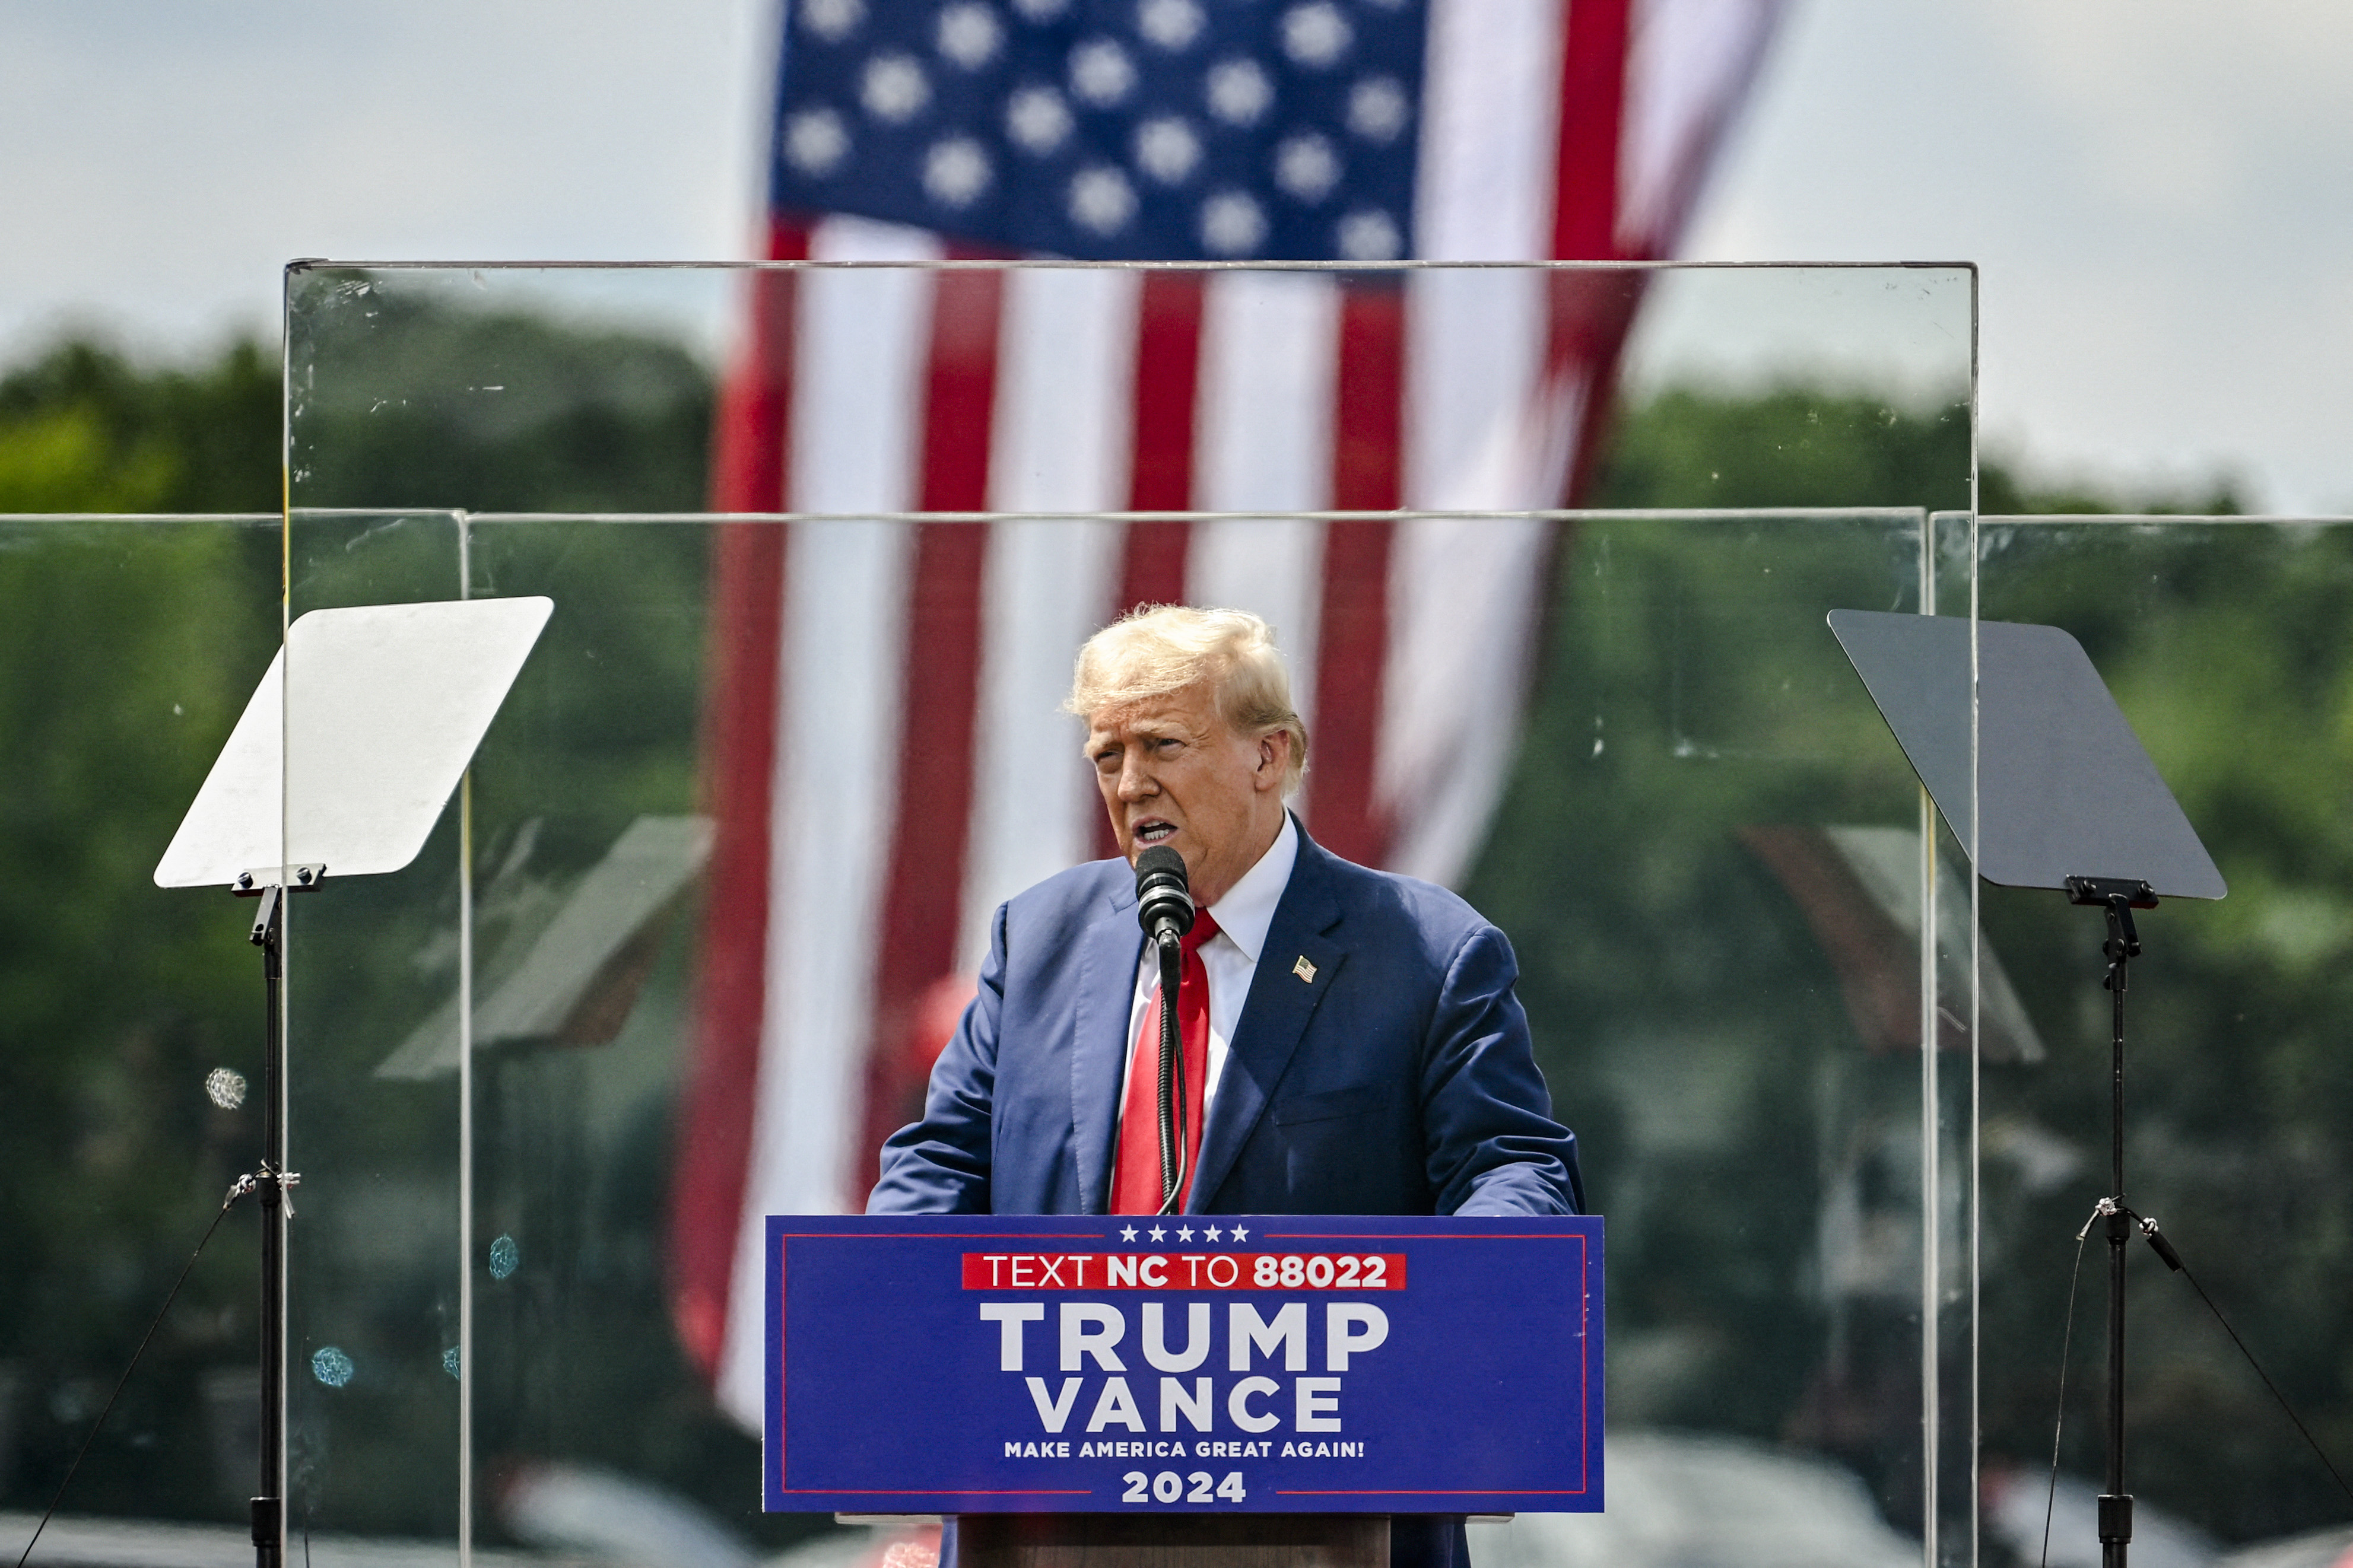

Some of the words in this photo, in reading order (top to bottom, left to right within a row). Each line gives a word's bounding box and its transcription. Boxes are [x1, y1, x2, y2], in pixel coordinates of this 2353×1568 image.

[982, 1255, 1093, 1287] TEXT
[1107, 1255, 1169, 1287] NC
[1181, 1255, 1239, 1287] TO
[1253, 1255, 1387, 1288] 88022
[979, 1302, 1389, 1373] TRUMP
[1024, 1376, 1342, 1433] VANCE
[1004, 1441, 1071, 1458] MAKE
[1078, 1441, 1187, 1458] AMERICA
[1195, 1441, 1273, 1458] GREAT
[1280, 1441, 1364, 1458] AGAIN!
[1122, 1470, 1247, 1504] 2024
